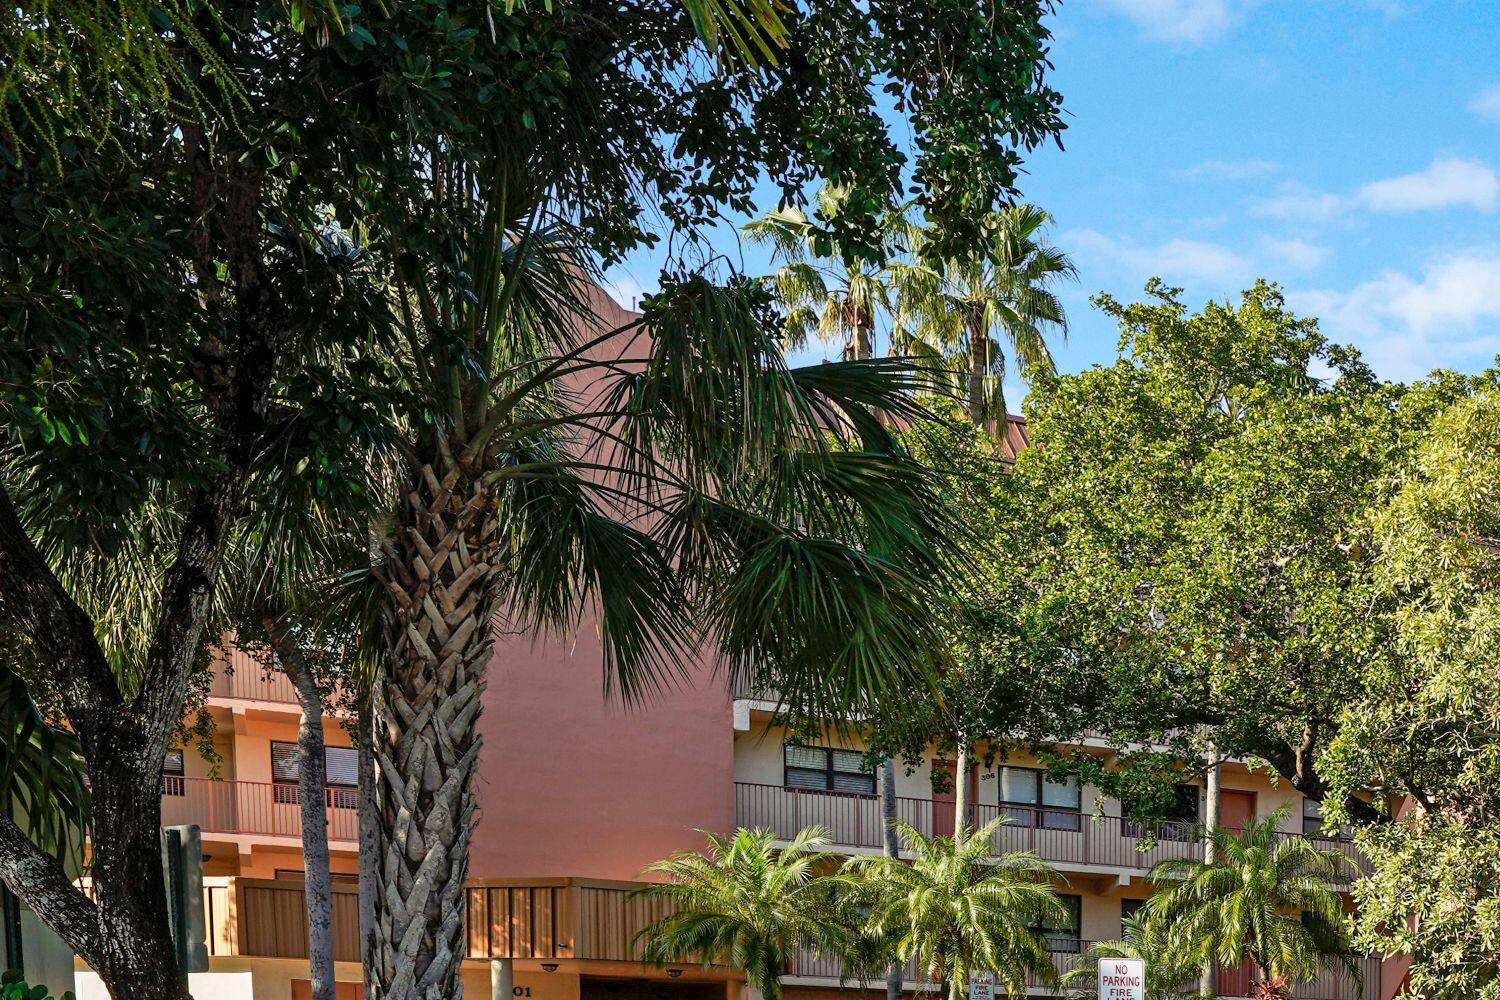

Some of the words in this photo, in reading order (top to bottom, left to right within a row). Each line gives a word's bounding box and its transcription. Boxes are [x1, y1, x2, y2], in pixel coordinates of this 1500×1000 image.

[1115, 965, 1128, 975] NO
[1103, 976, 1140, 987] PARKING
[1110, 988, 1133, 997] FIRE
